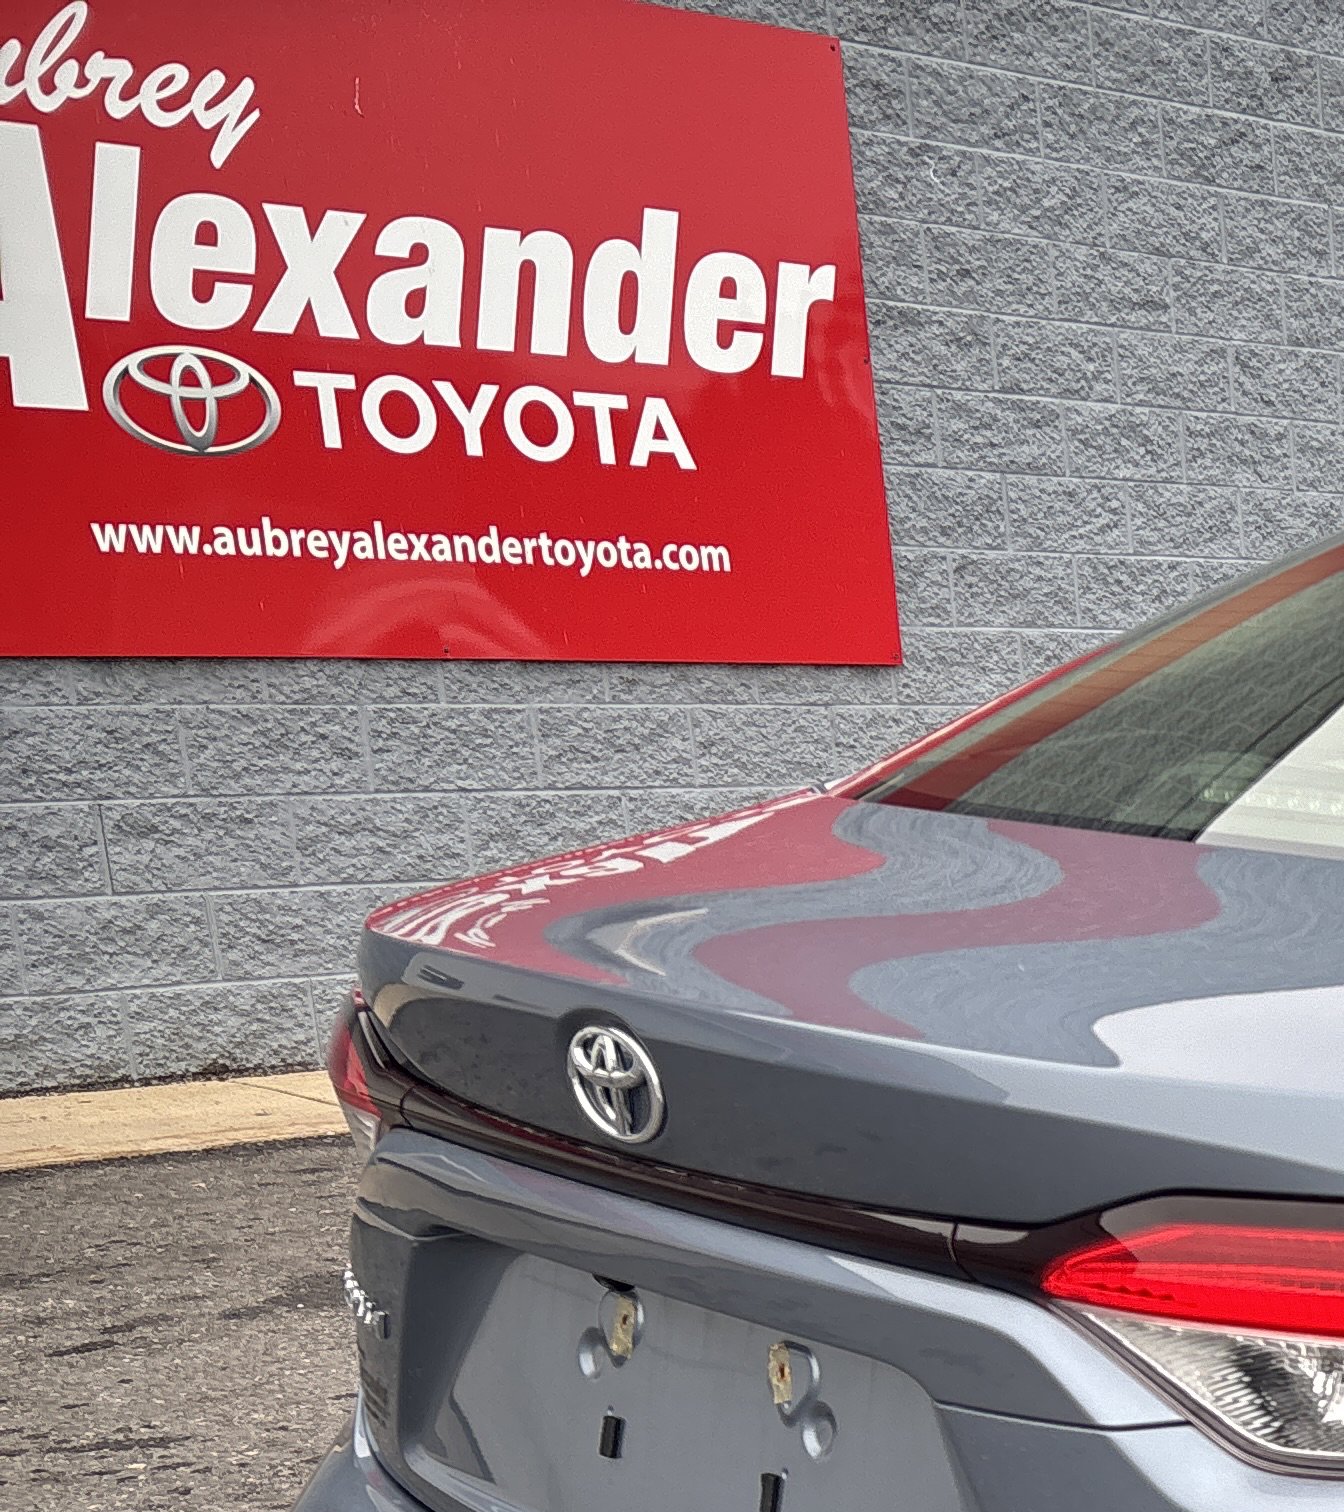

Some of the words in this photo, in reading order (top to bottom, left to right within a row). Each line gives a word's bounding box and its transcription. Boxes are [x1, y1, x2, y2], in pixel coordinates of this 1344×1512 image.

[0, 0, 260, 170] brey
[292, 370, 698, 471] TOYOTA
[89, 516, 732, 578] www.aubreyalexandertoyota.com
